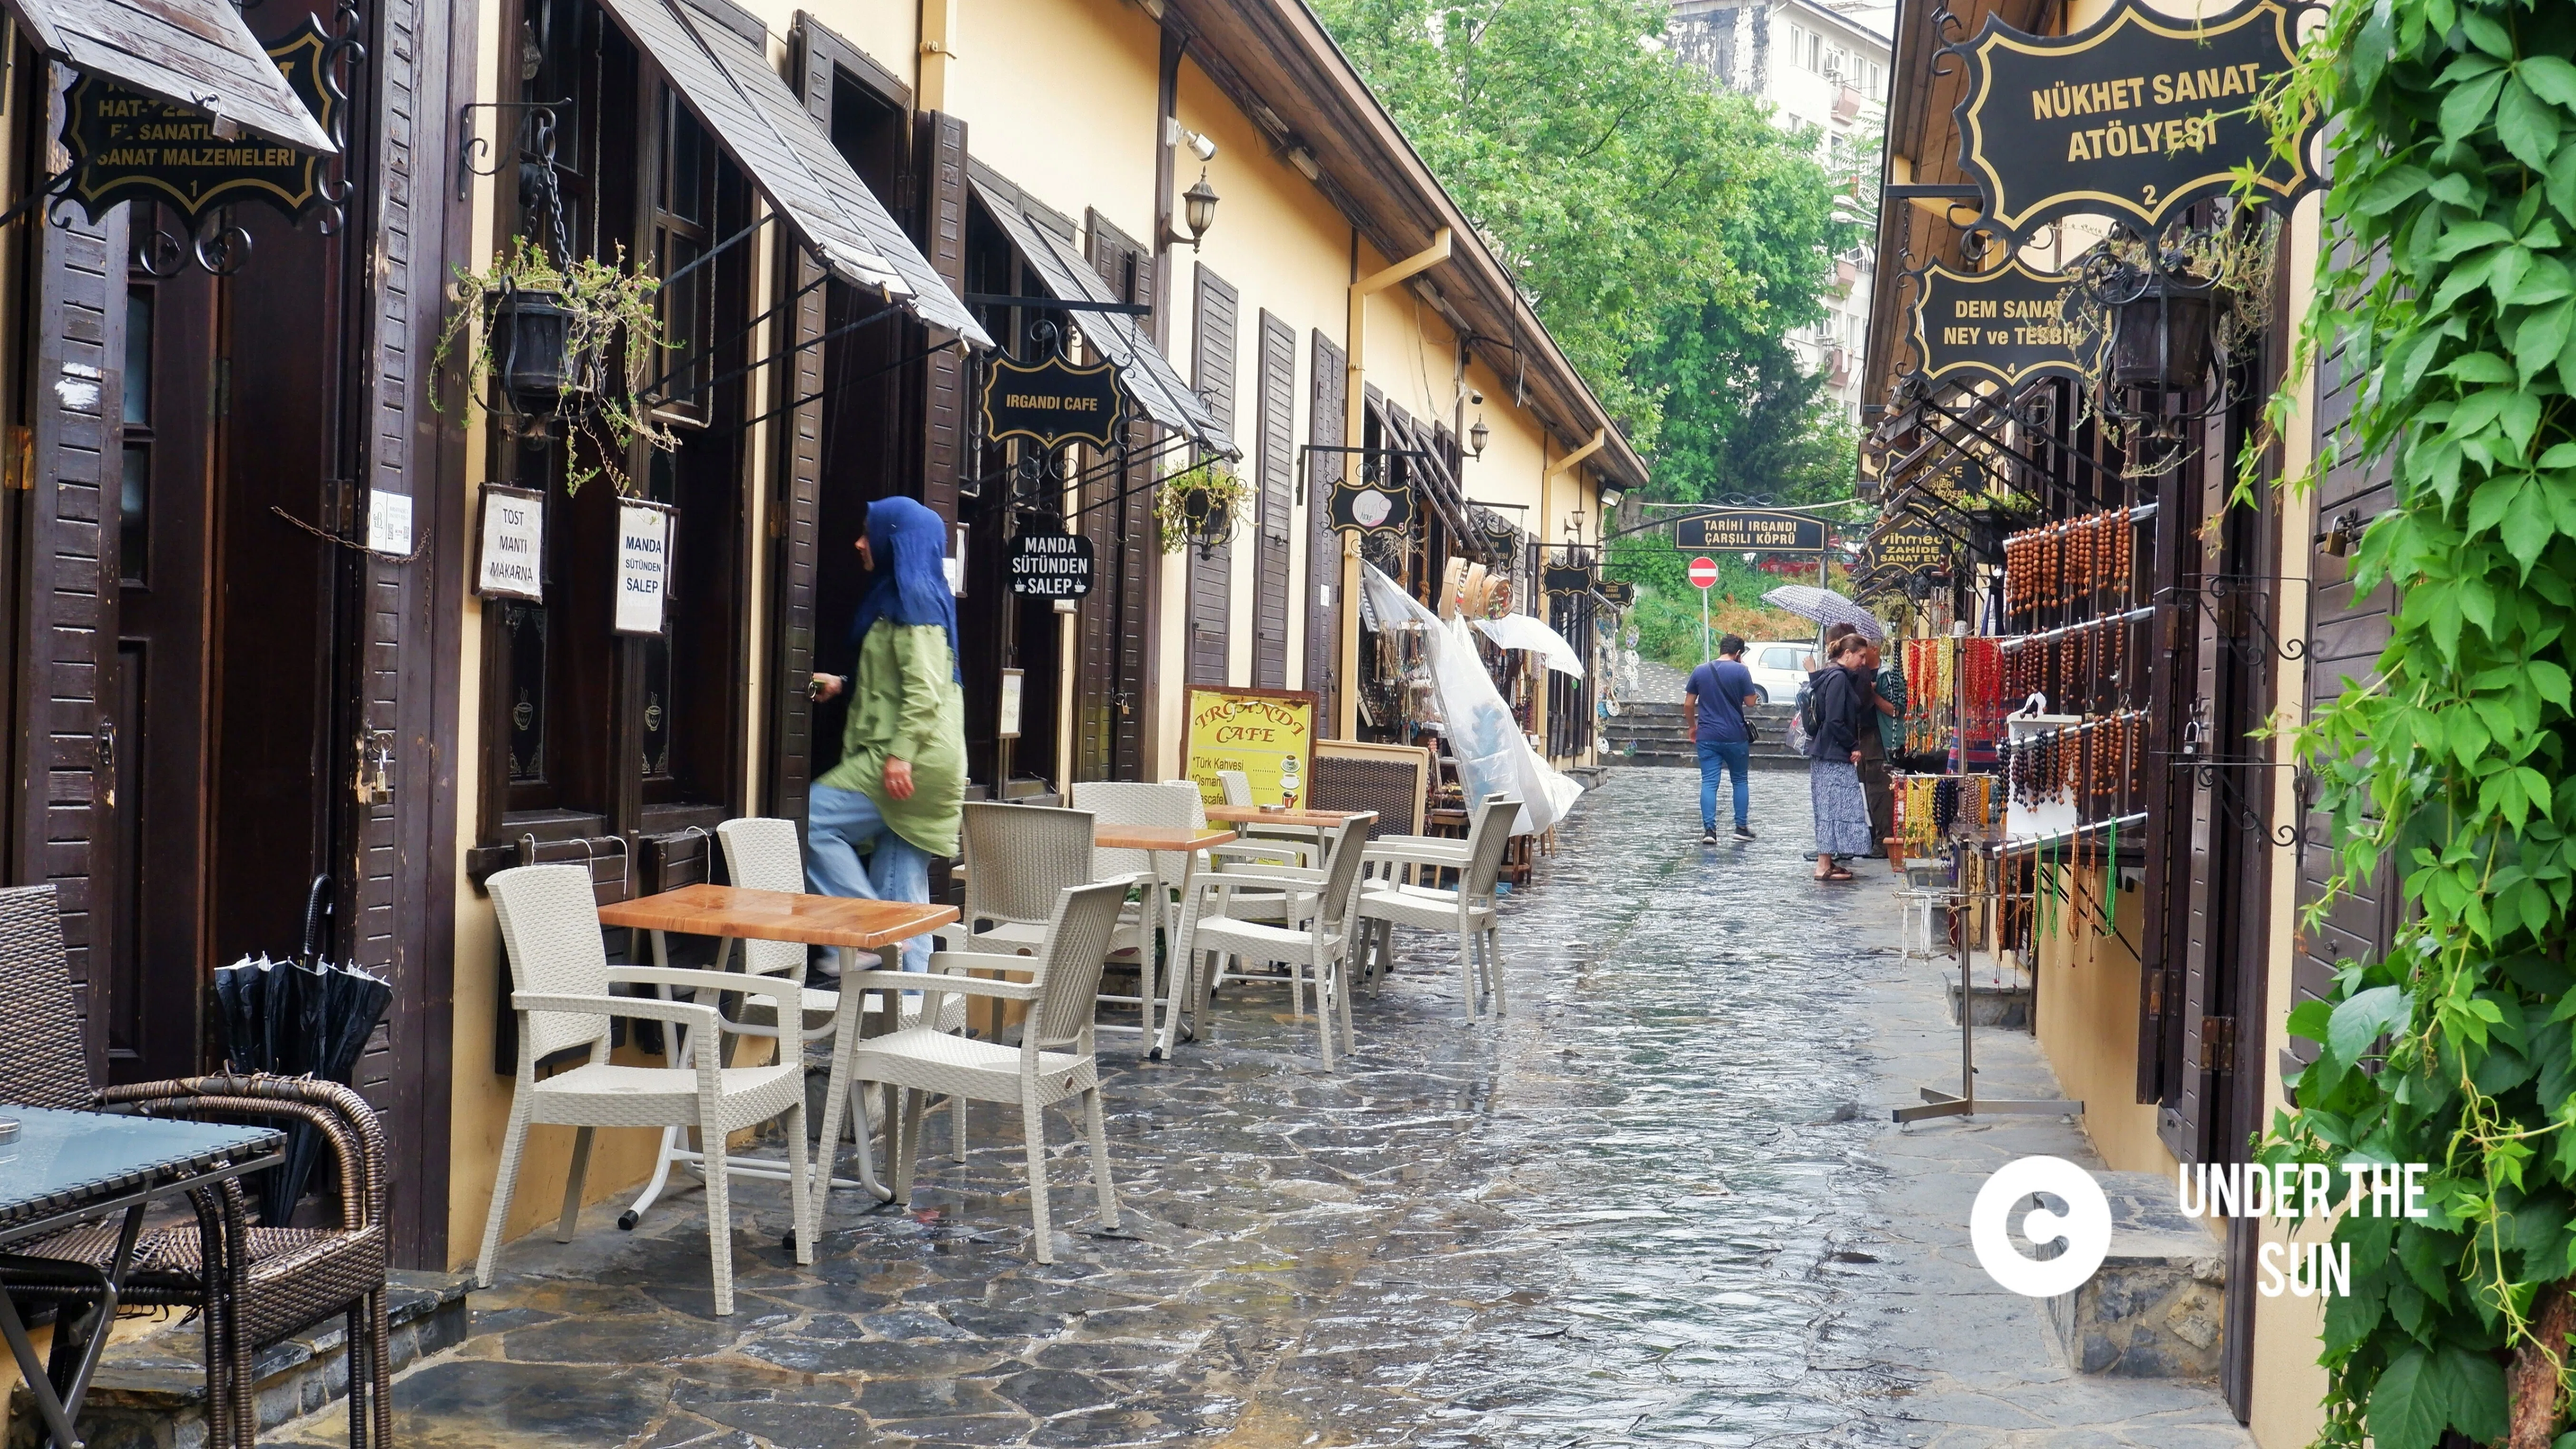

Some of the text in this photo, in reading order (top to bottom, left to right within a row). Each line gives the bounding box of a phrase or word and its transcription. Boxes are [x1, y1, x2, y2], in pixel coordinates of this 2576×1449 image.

[2032, 62, 2260, 120] NÜKHET SANAT
[2067, 108, 2217, 162] ATÖLYESİ
[97, 148, 157, 166] SANAT
[190, 179, 198, 197] 1
[2142, 185, 2157, 206] 2
[1956, 300, 1997, 318] DEM
[1944, 327, 1980, 345] NEY
[1987, 331, 2008, 345] ve
[2007, 362, 2016, 375] 4
[1006, 394, 1098, 411] IRGANDI CAFE
[1047, 432, 1053, 441] 3
[503, 509, 524, 526] TOST
[1704, 518, 1797, 532] TARİHİ IRGANDI
[1398, 522, 1404, 531] 5
[500, 535, 527, 554] MANTI
[626, 536, 661, 554] MANDA
[1025, 537, 1077, 553] MANDA
[1705, 532, 1795, 546] ÇARŞILI KÖPRÜ
[1886, 545, 1939, 554] ZAHİDE
[490, 562, 533, 582] MAKARNA
[626, 558, 661, 572] SÜTÜNDEN
[1012, 555, 1087, 574] SÜTÜNDEN
[627, 577, 658, 594] SALEP
[1028, 578, 1072, 594] SALEP
[1195, 702, 1305, 737] IRGANDI
[1216, 726, 1275, 743] CAFE
[1214, 757, 1244, 771] Kahvesi
